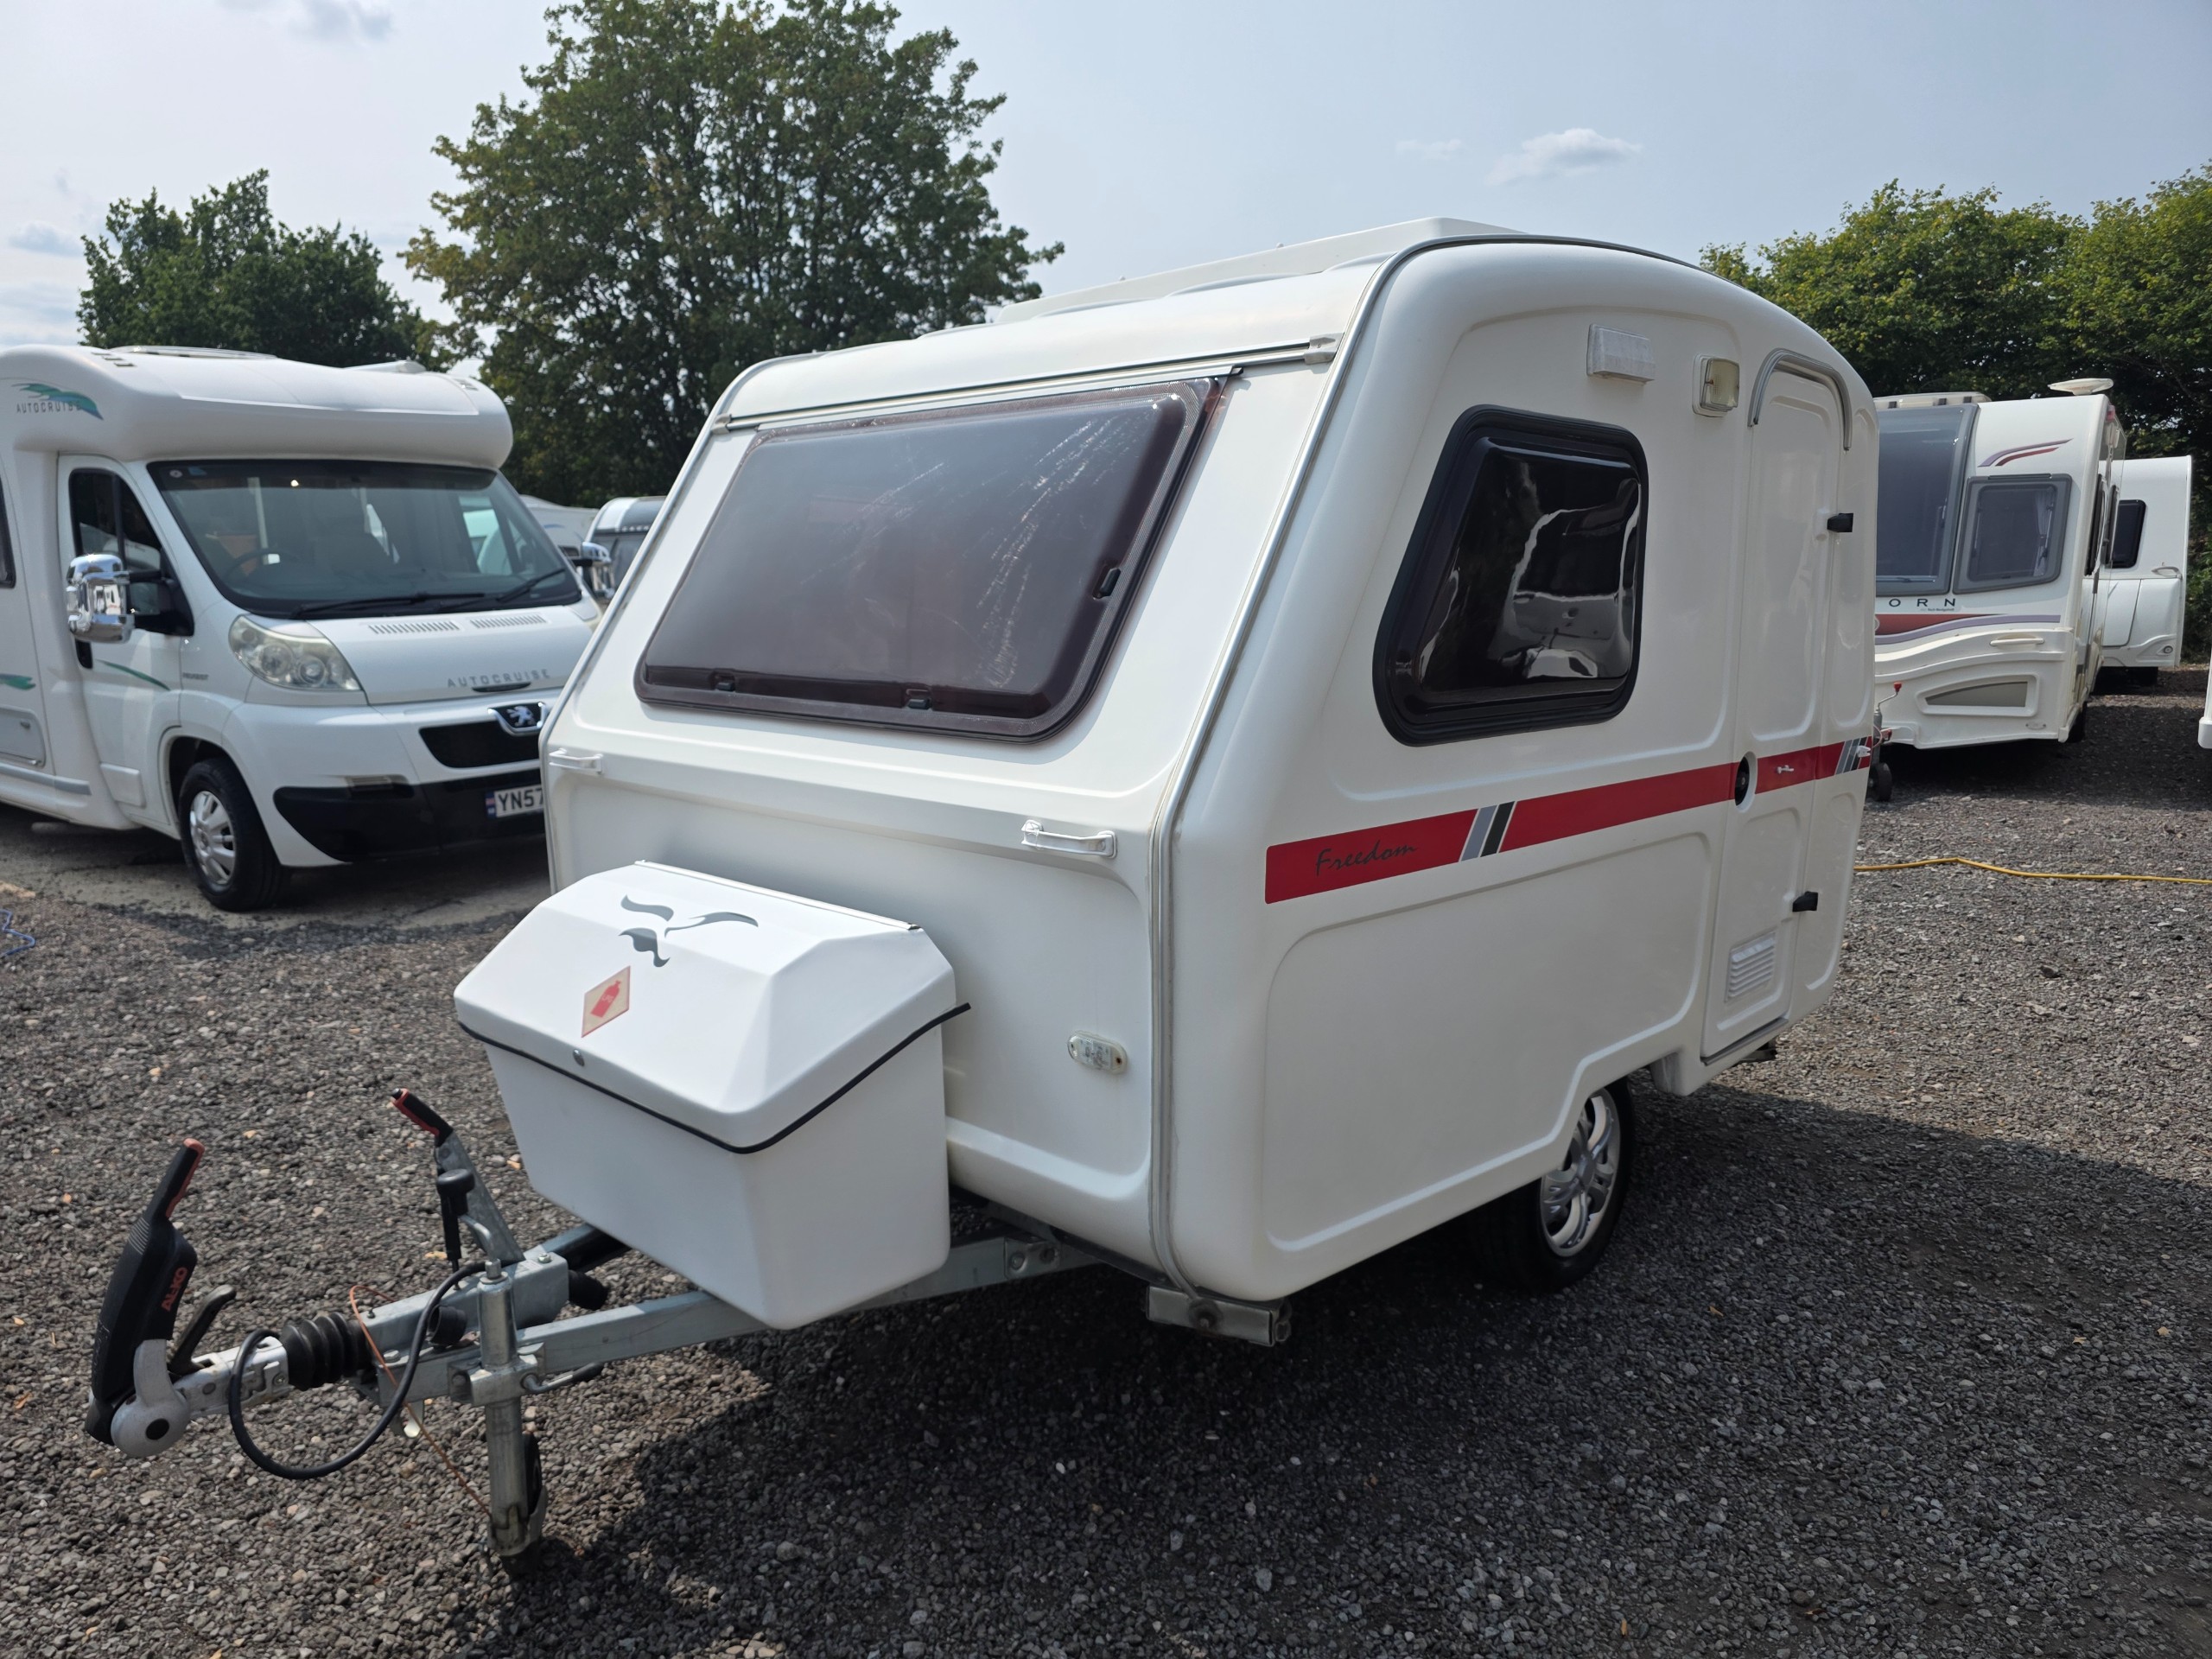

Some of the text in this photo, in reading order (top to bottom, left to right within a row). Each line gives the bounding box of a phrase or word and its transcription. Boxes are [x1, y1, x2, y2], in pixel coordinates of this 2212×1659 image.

[448, 669, 550, 689] AUTOCRUISE
[499, 787, 543, 811] YN57
[1316, 840, 1415, 877] Freedom
